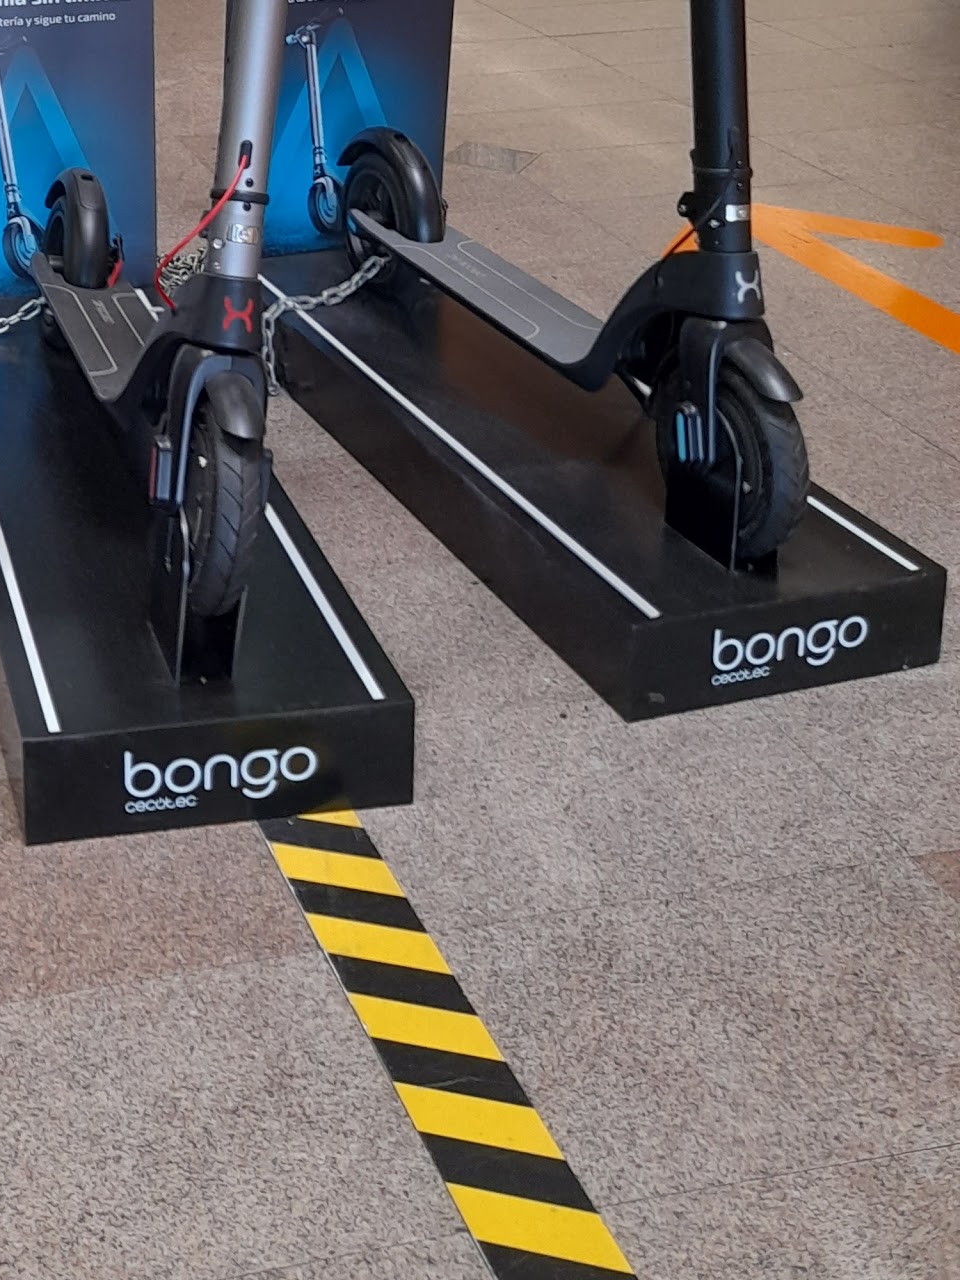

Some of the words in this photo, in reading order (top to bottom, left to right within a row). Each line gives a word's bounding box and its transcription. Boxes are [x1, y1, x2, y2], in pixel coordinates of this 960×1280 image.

[25, 17, 33, 27] y
[34, 13, 62, 27] sigue
[64, 13, 76, 24] tu
[77, 11, 116, 23] camino
[713, 615, 868, 666] bongo
[711, 665, 771, 686] cecotec
[123, 746, 318, 799] bongo
[124, 794, 199, 814] cecotec
